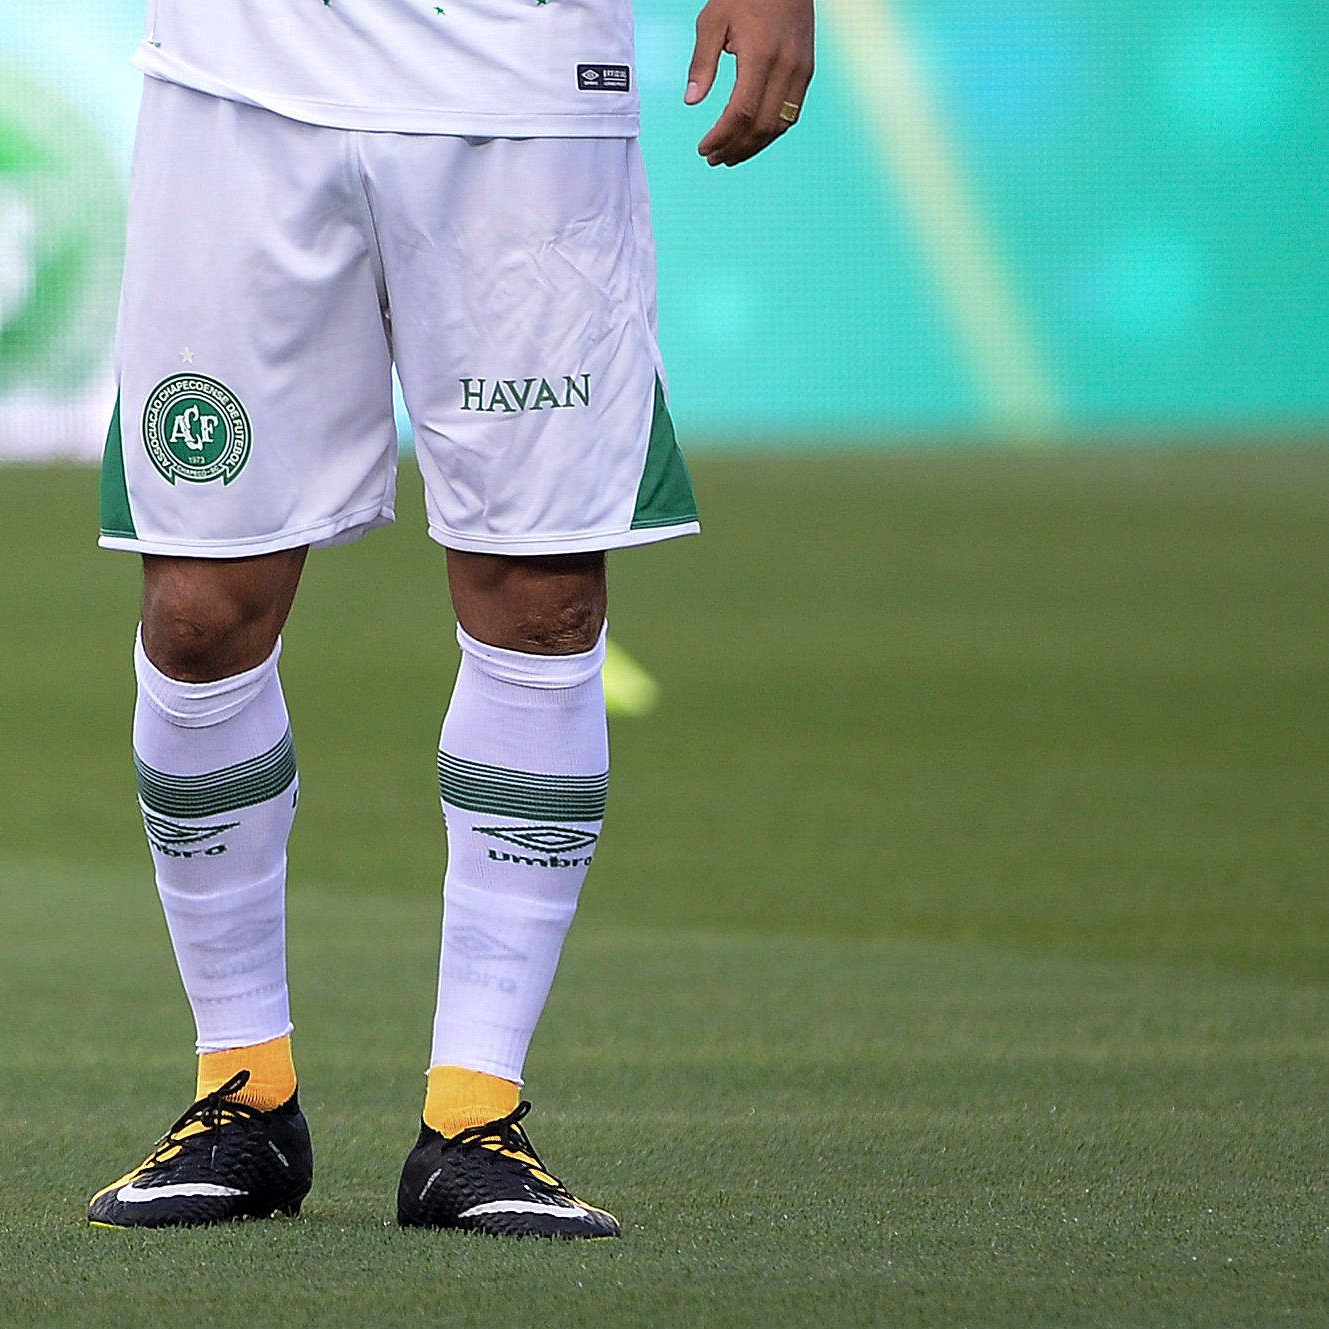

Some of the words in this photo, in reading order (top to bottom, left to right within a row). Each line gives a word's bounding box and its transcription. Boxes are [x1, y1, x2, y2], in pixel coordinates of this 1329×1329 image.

[459, 373, 592, 414] HAVAN
[159, 380, 228, 404] CHAPECOENSE
[226, 419, 244, 466] FUTEBOL
[488, 849, 592, 868] umbro
